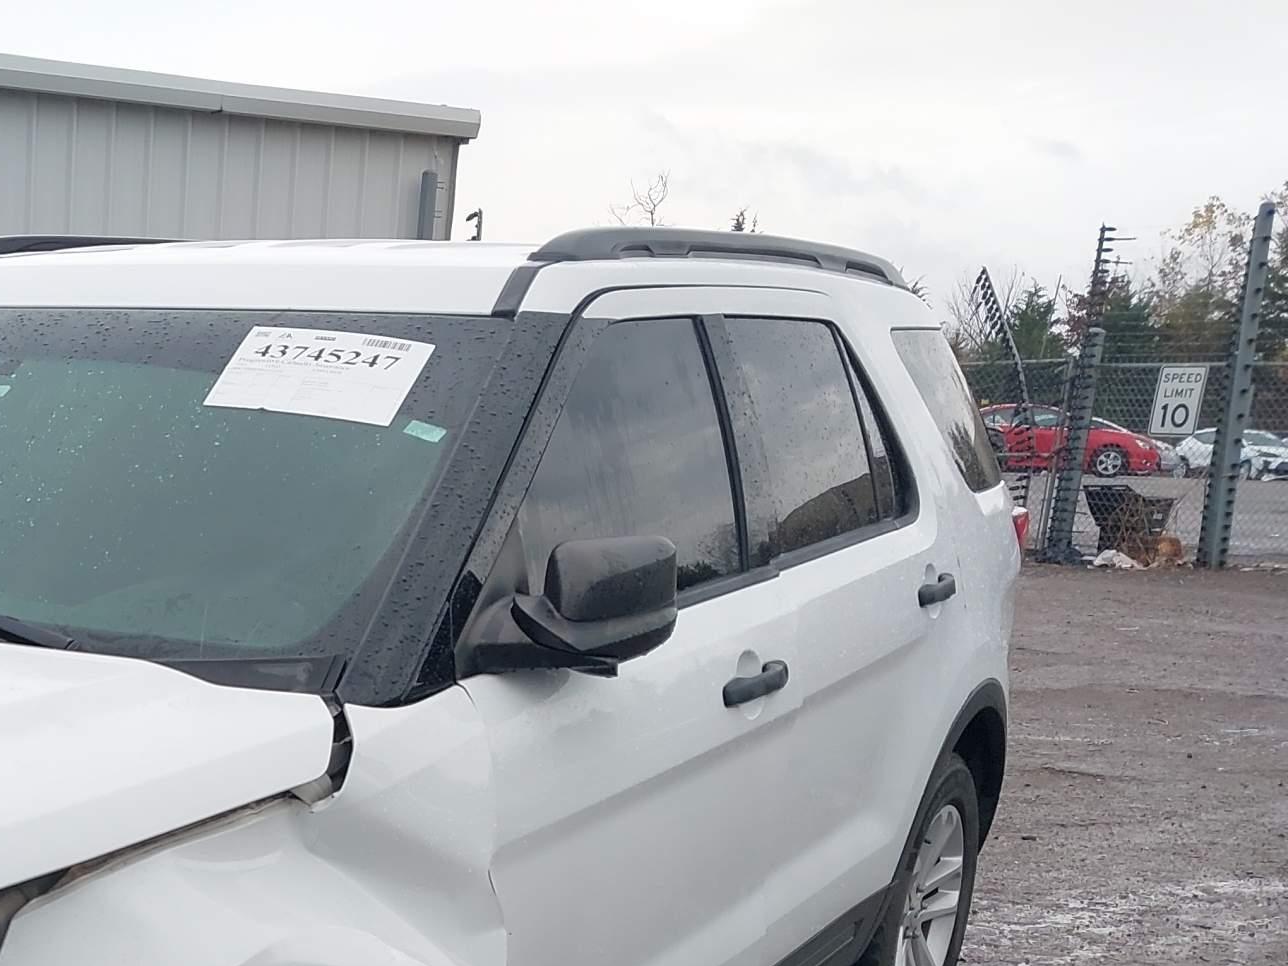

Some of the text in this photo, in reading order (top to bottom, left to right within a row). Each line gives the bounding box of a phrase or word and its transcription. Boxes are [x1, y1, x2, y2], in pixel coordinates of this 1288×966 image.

[255, 343, 401, 371] 43745247
[1163, 373, 1203, 384] SPEED
[1163, 388, 1195, 399] LIMIT
[1160, 403, 1190, 429] 10
